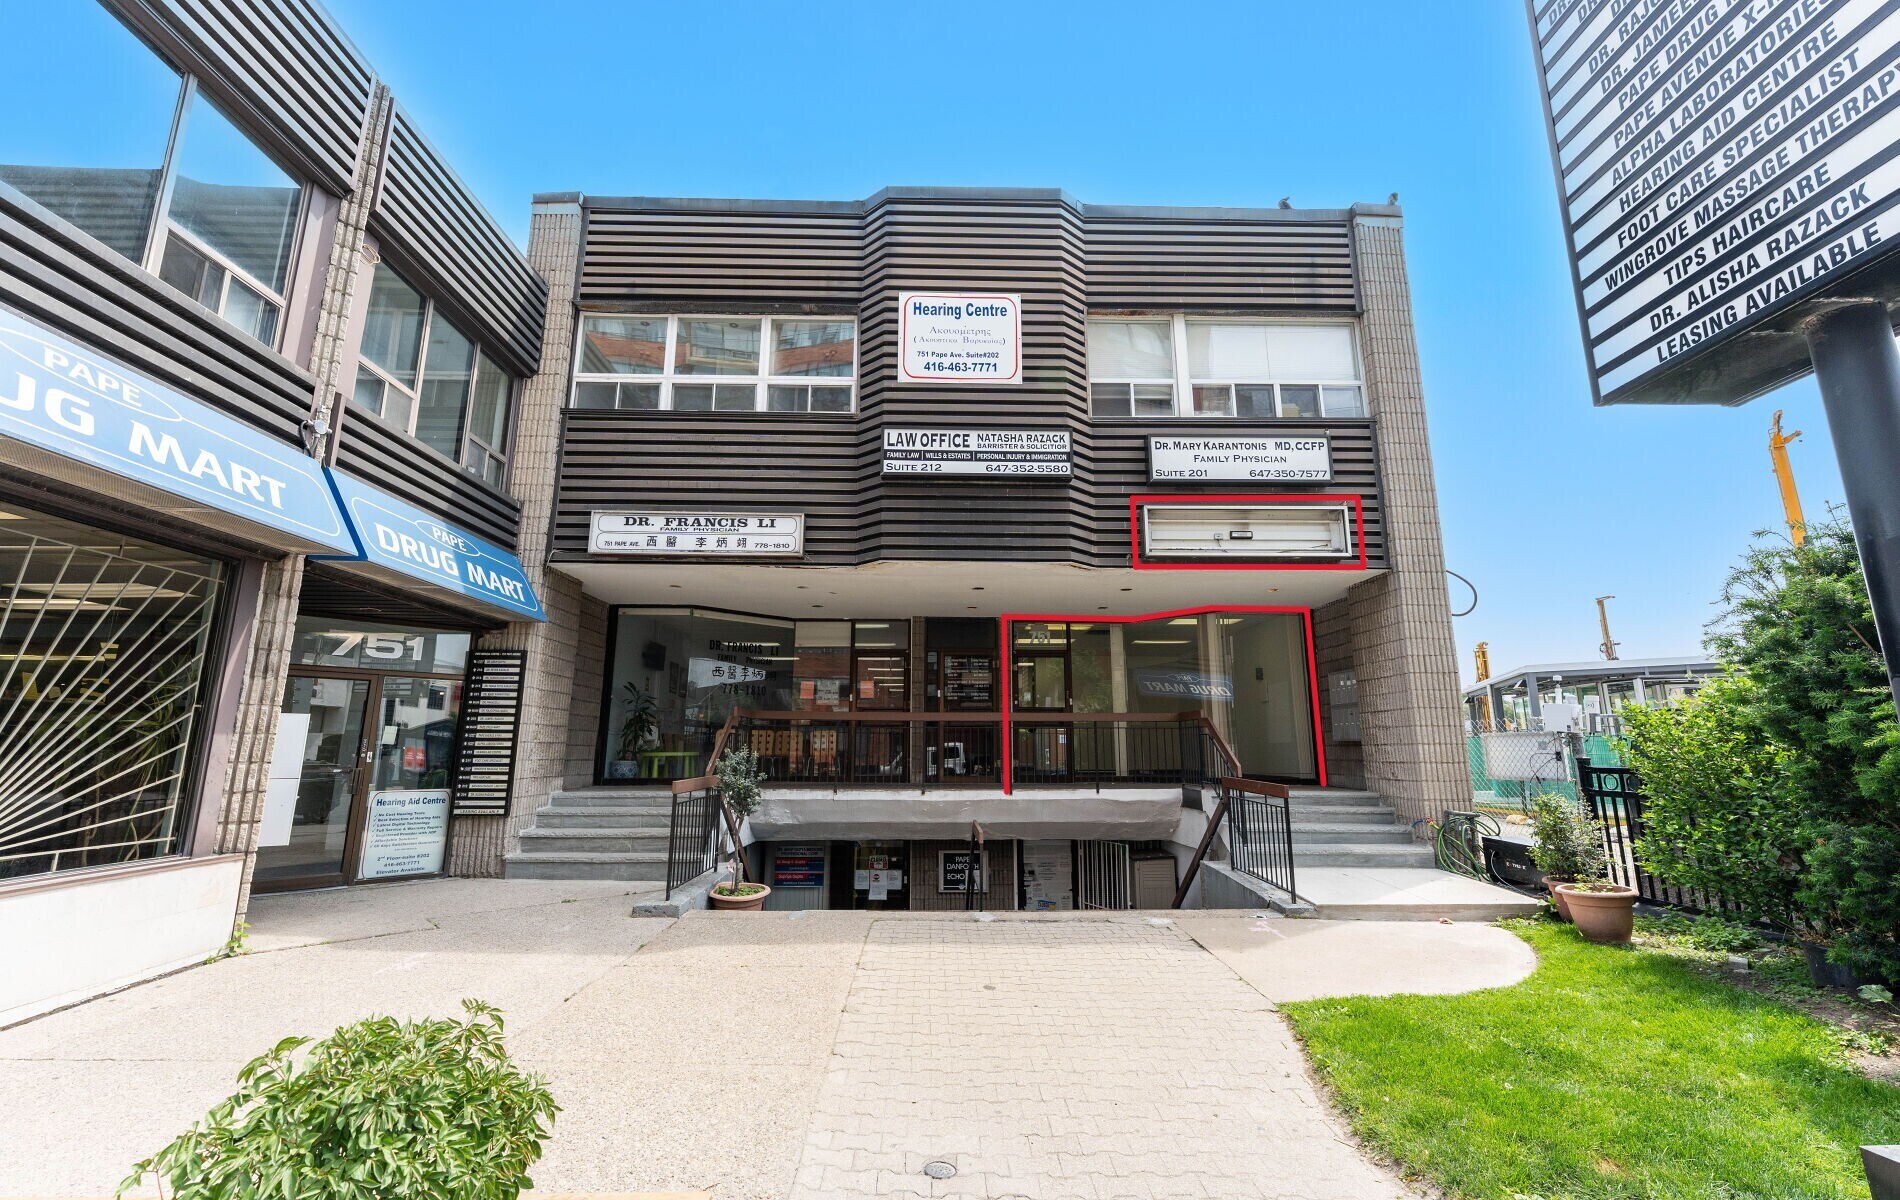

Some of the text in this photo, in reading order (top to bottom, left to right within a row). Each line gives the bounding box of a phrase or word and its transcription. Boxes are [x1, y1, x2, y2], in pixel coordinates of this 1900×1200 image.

[1600, 0, 1697, 95] DR. JAMEE
[1618, 4, 1719, 111] PAPE DRUG
[1588, 44, 1615, 75] DR.
[1613, 100, 1656, 149] PAPE
[1661, 25, 1736, 108] AVENUE
[1619, 20, 1838, 213] HEARING AID CENTRE
[1612, 130, 1666, 187] ALPHA
[1617, 47, 1859, 249] FOOT CARE SPECIALIST
[1604, 220, 1689, 291] WINGROVE
[1694, 147, 1790, 230] MASSAGE
[1663, 162, 1832, 286] TIPS HAIRCARE
[1649, 182, 1872, 332] DR. ALISHA RAZACK
[1656, 221, 1882, 363] LEASING AVAILABLE
[913, 302, 1007, 320] Hearing Centre
[931, 351, 948, 359] Pape
[966, 351, 1000, 359] Suite#202
[43, 345, 143, 408] PAPE
[924, 362, 997, 372] 416-463-7771
[887, 432, 970, 448] LAW OFFICE
[977, 433, 1066, 444] NATASHA RAZACK
[1173, 441, 1201, 450] MARY
[1203, 441, 1267, 451] KARANTONIS
[128, 419, 286, 510] MART
[948, 452, 971, 460] ESTATES
[1194, 454, 1287, 463] FAMILY PHYSICIAN
[920, 463, 942, 472] 212
[985, 464, 1068, 473] 647-352-5580
[1188, 469, 1208, 478] 201
[1249, 469, 1327, 478] 647-350-7577
[624, 516, 777, 528] DR. FRANCIS LI
[431, 525, 467, 552] PAPE
[374, 521, 526, 602] DRUG MART
[332, 633, 425, 661] 751
[709, 639, 724, 651] DR.
[727, 641, 763, 655] FRANCIS
[722, 683, 767, 696] 778-1810
[376, 796, 447, 807] Hearing Aid Centre
